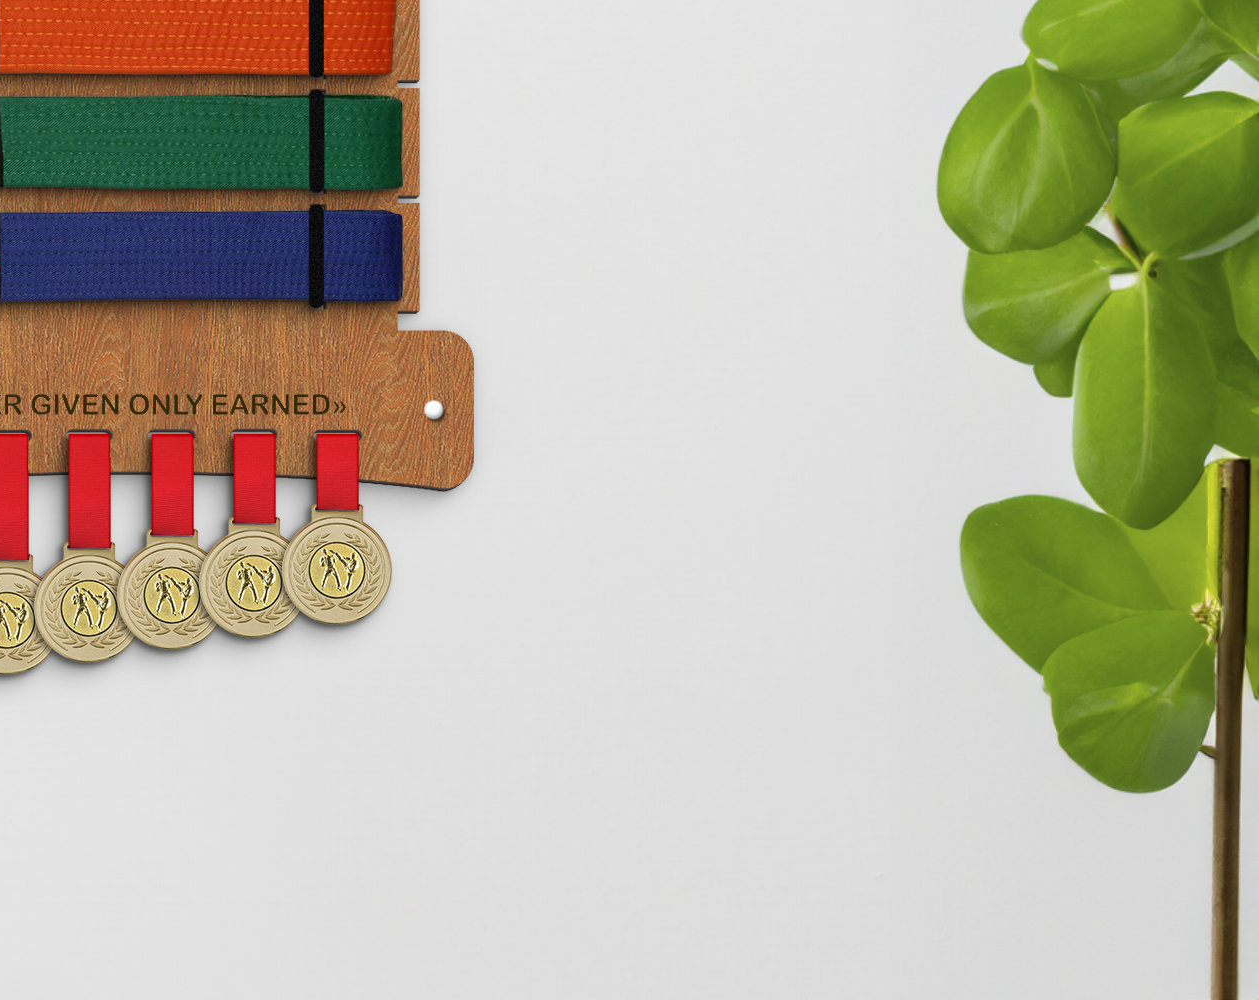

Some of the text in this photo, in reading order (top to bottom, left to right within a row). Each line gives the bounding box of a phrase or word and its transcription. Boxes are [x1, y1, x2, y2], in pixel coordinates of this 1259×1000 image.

[31, 393, 119, 415] GIVEN
[129, 393, 203, 415] ONLY
[211, 393, 347, 415] EARNED»
